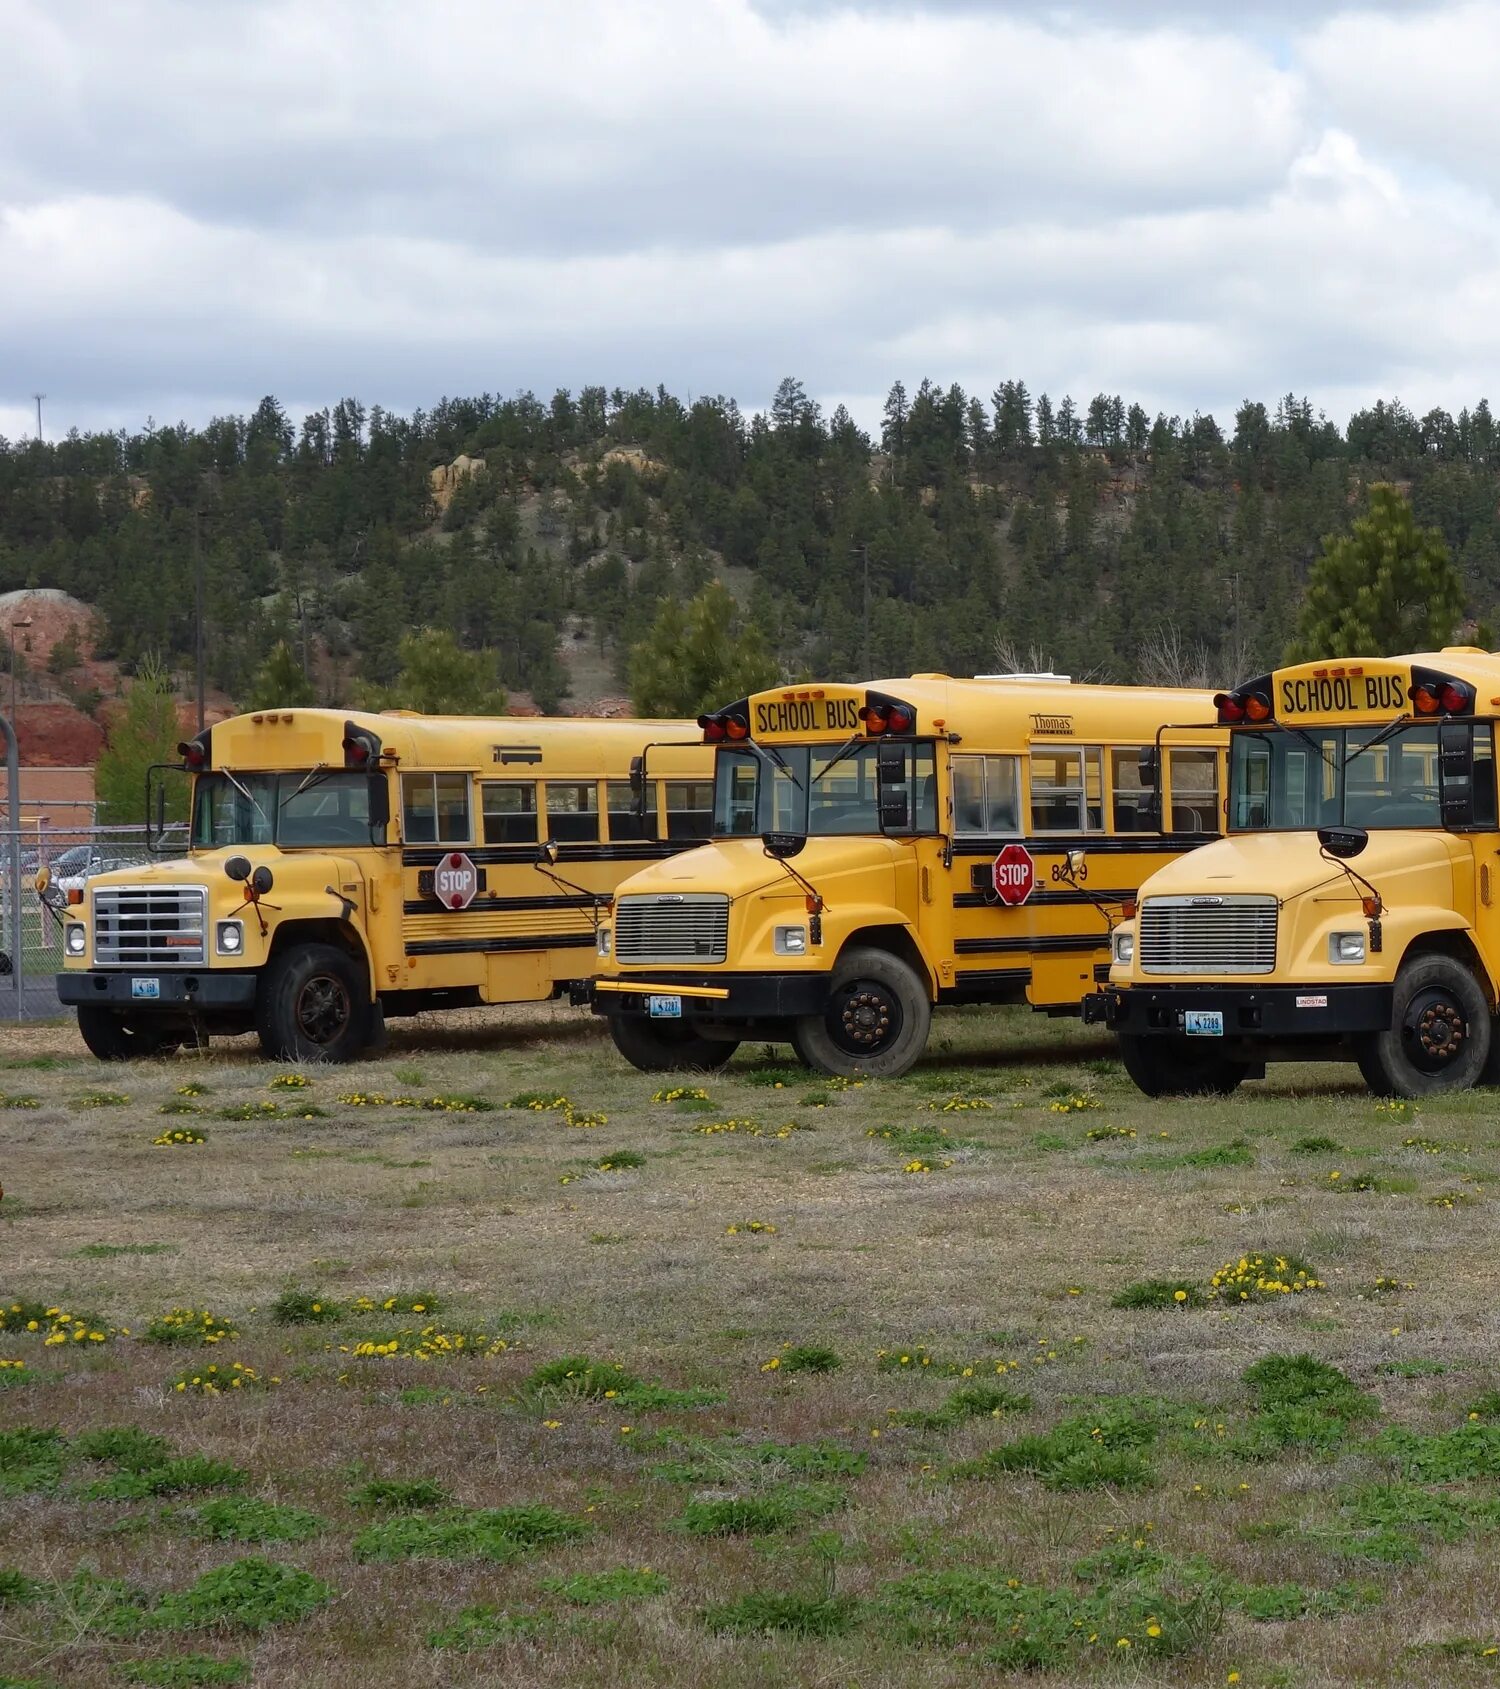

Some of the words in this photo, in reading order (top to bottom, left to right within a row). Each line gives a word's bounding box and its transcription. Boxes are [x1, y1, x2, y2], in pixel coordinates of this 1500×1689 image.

[1283, 678, 1358, 713] SCHOOL
[1365, 676, 1404, 709] BUS
[758, 701, 820, 732] SCHOOL
[826, 699, 858, 729] BUS
[1029, 713, 1073, 729] Thomas
[440, 870, 472, 891] STOP
[1000, 863, 1029, 886] STOP
